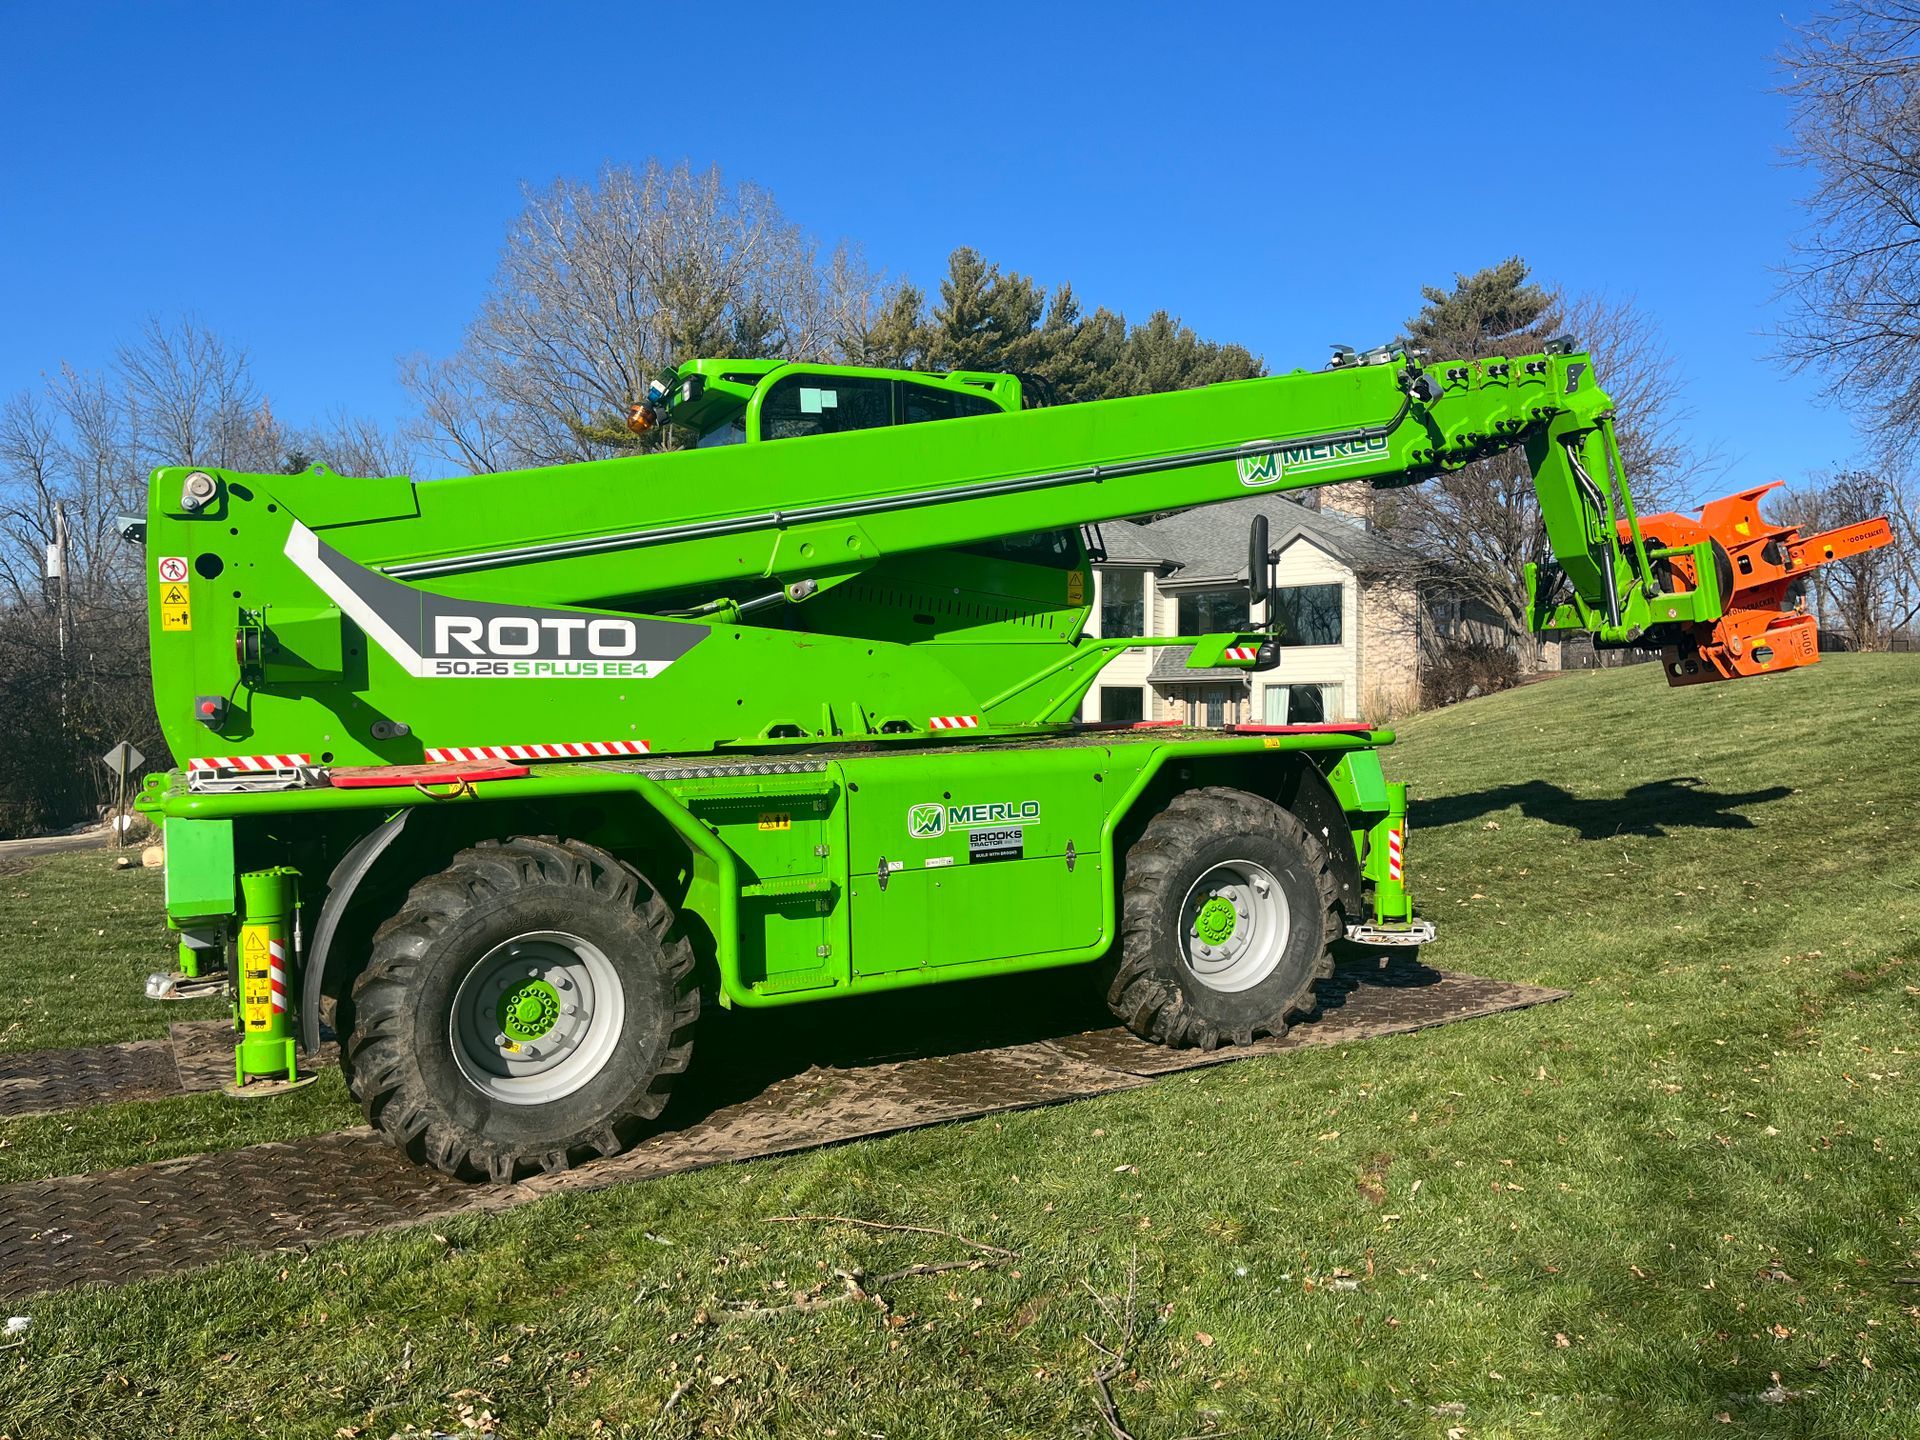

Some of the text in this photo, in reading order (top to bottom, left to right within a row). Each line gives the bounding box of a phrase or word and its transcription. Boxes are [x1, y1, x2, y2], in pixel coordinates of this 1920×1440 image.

[434, 615, 637, 657] ROTO
[436, 661, 649, 676] 50.26 S PLUS EE4
[949, 801, 1039, 823] MERLO
[970, 830, 1023, 843] BROOKS
[970, 840, 1003, 848] TRACTOR
